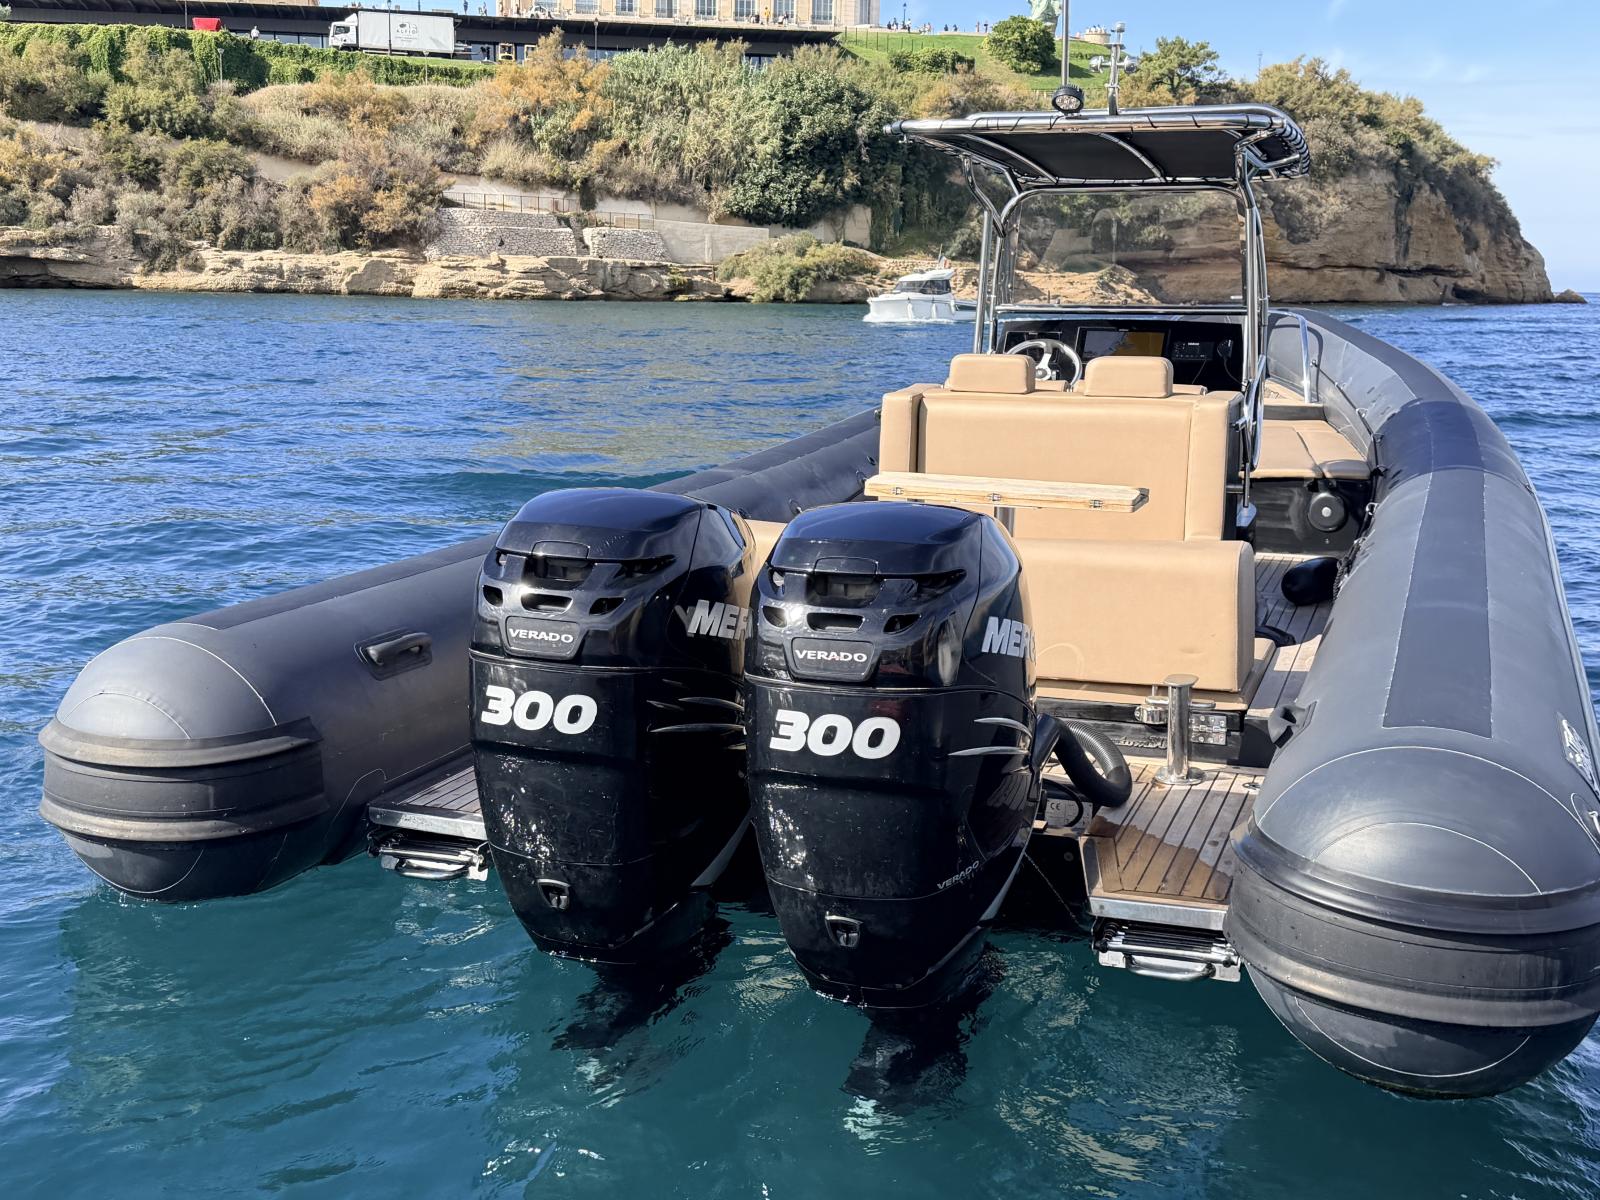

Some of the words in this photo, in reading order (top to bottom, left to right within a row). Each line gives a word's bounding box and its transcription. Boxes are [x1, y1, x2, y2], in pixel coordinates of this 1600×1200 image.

[508, 628, 574, 644] VERADO
[794, 649, 868, 663] VERADO
[481, 684, 598, 735] 300
[769, 709, 901, 759] 300
[936, 860, 980, 889] VERADO
